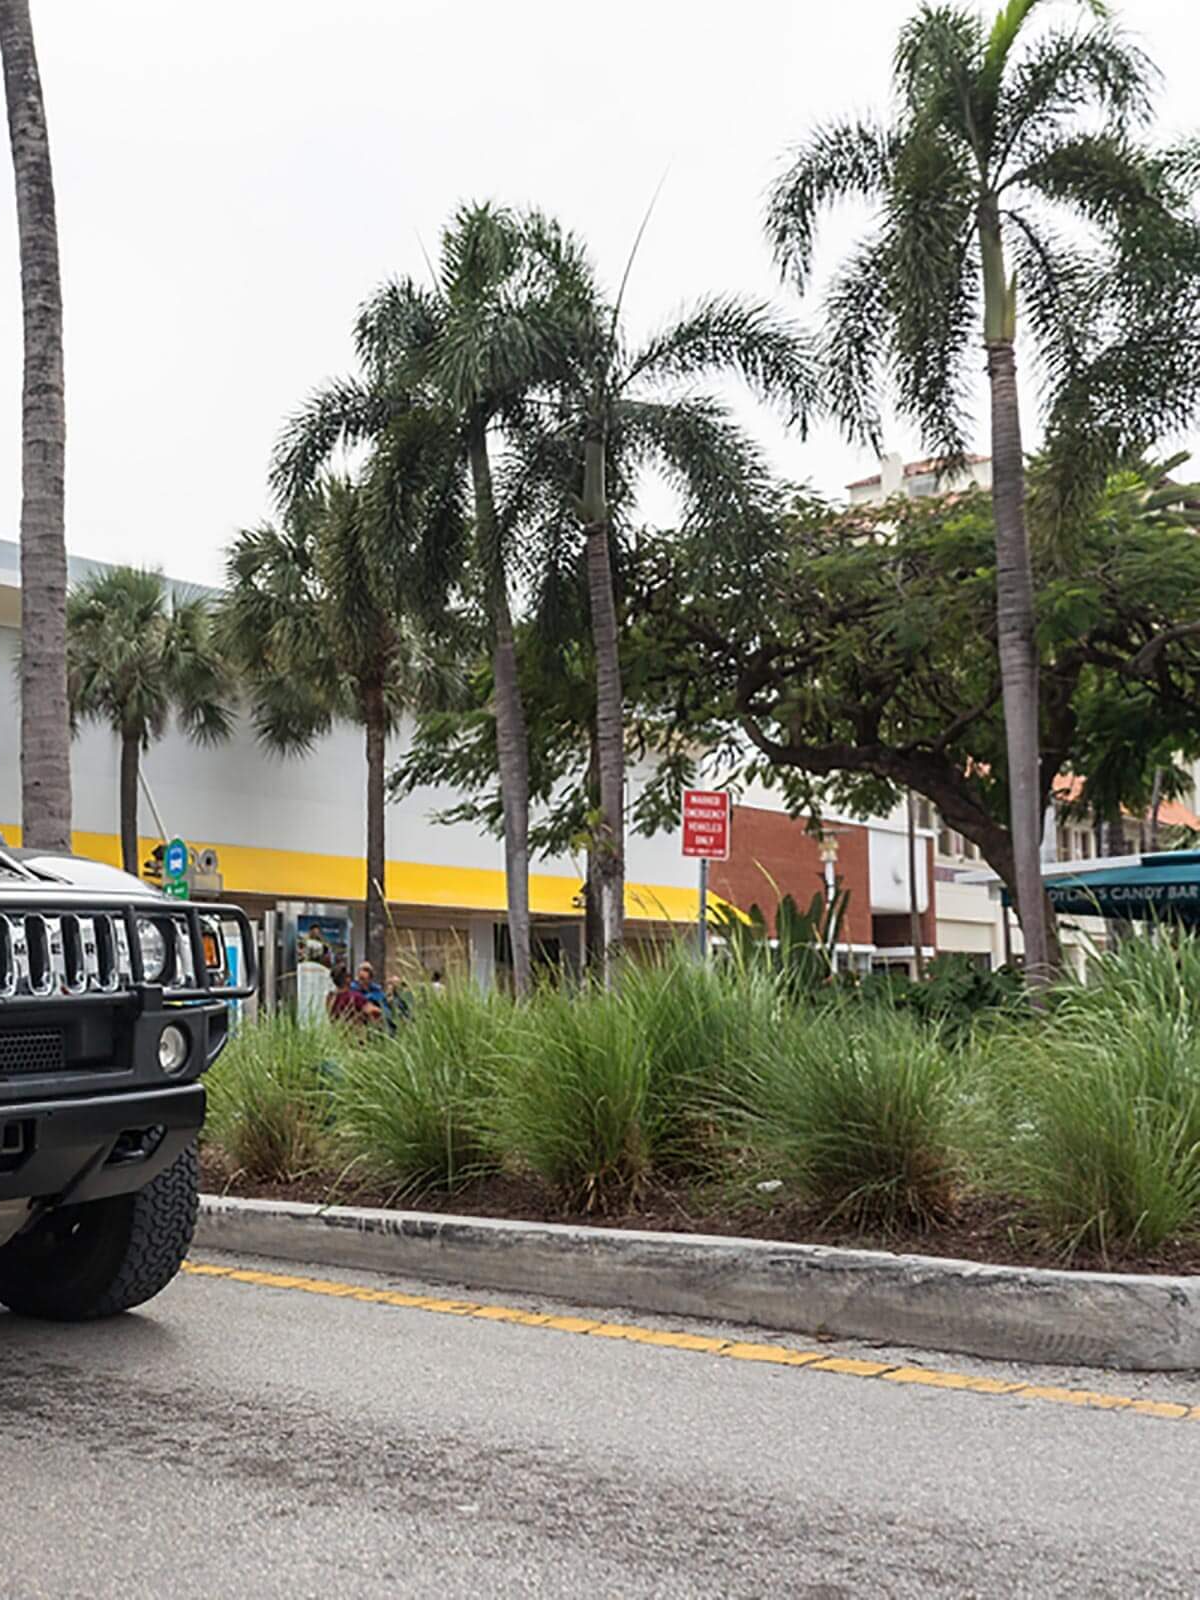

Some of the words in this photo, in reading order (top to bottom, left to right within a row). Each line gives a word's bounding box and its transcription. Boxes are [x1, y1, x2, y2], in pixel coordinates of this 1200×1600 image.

[696, 835, 714, 846] ONLY
[1111, 886, 1164, 900] CANDY
[1168, 885, 1198, 899] BAR
